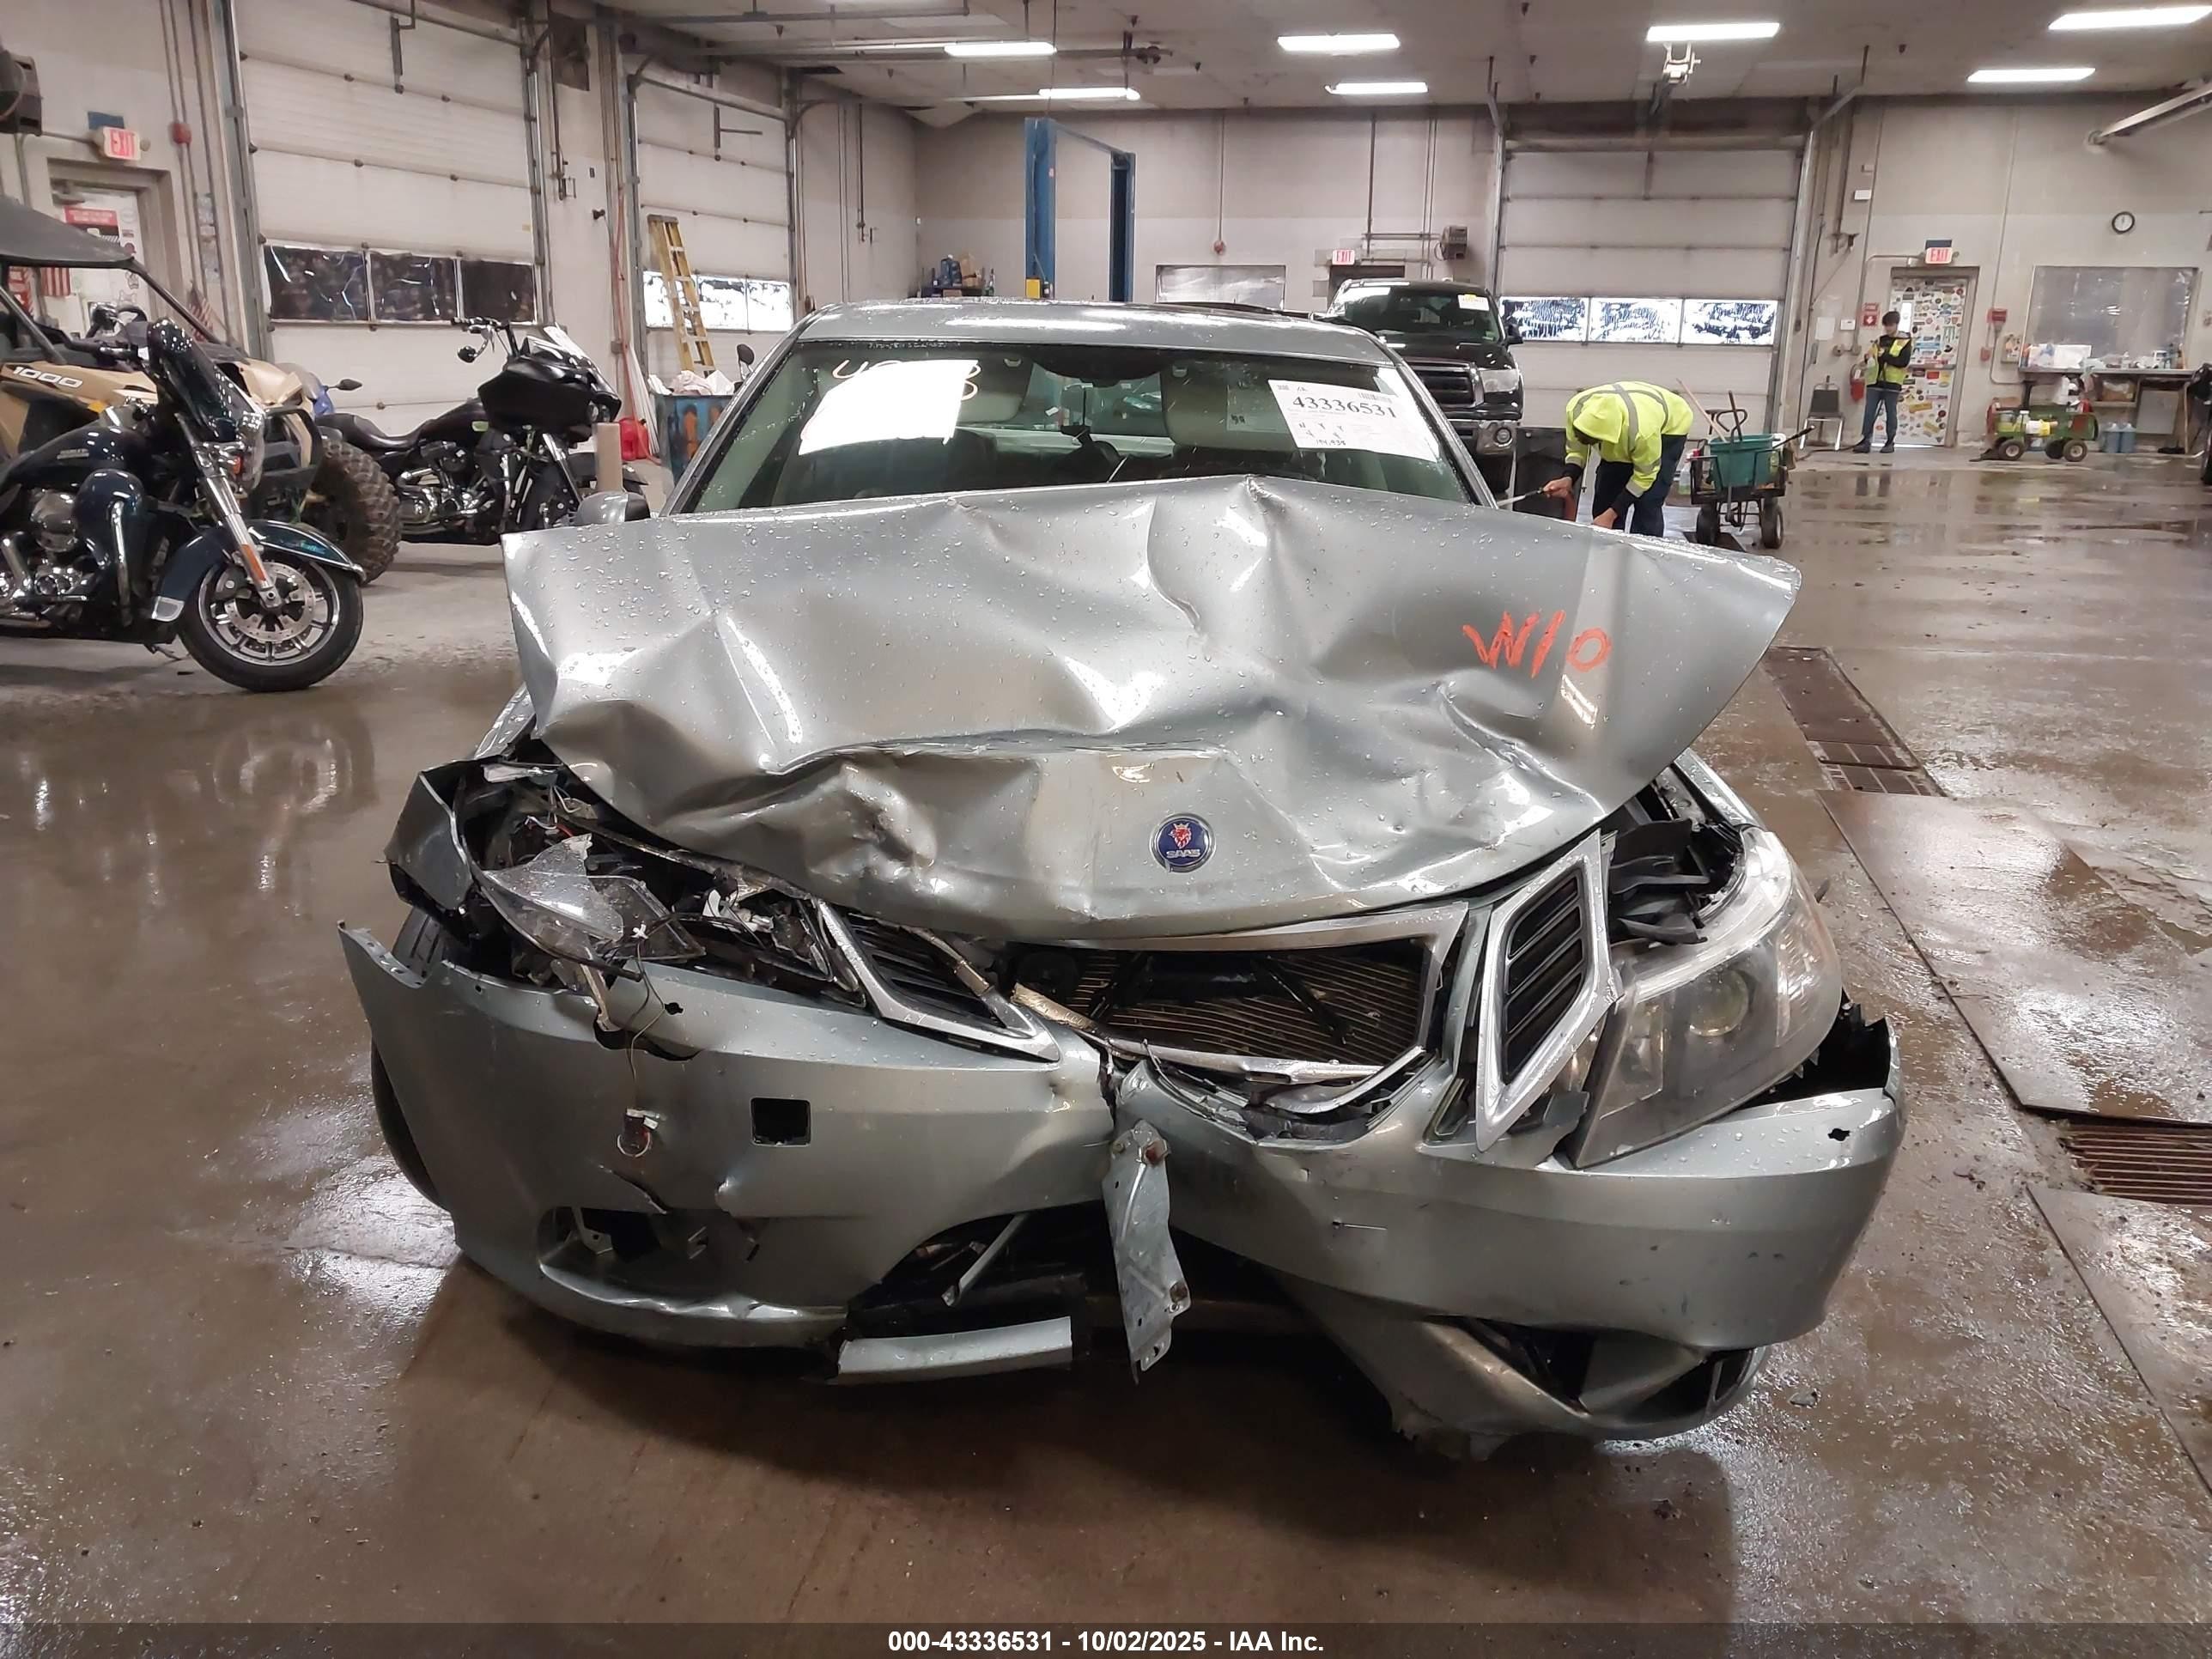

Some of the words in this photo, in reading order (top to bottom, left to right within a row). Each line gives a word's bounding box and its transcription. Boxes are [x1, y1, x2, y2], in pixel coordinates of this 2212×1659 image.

[109, 129, 136, 158] EXIT
[1335, 249, 1352, 263] EXIT
[1929, 247, 1950, 262] EXIT
[13, 366, 83, 388] 1000
[1291, 395, 1397, 419] 43336531
